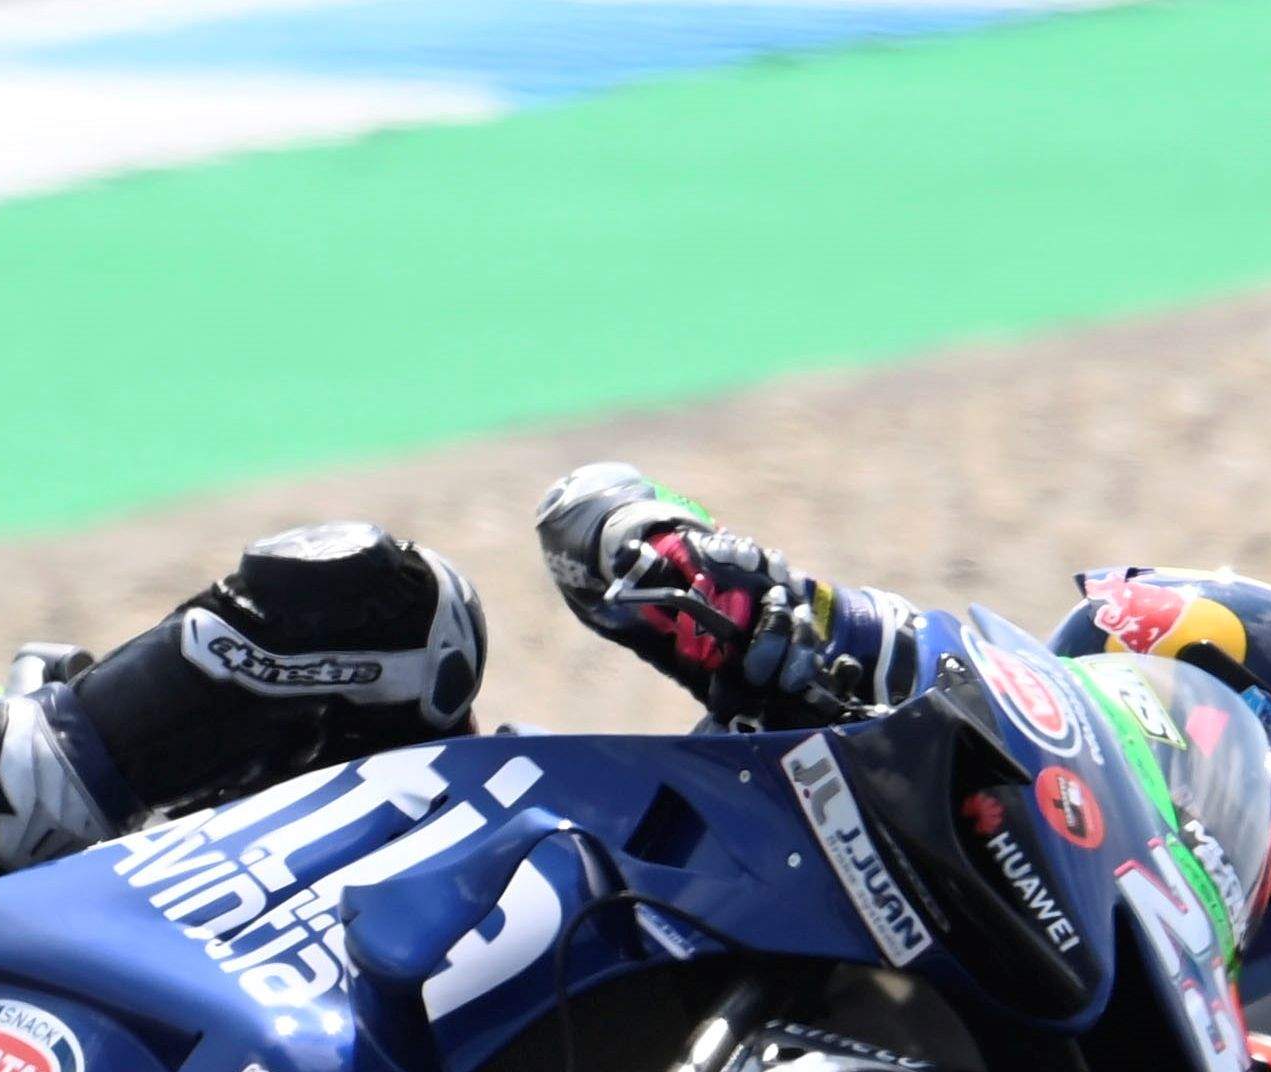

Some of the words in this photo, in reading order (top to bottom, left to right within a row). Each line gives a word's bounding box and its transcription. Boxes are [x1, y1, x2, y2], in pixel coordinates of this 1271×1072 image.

[209, 637, 383, 685] alpinestars
[834, 827, 925, 950] J.JUAN
[986, 831, 1080, 953] HUAWEI
[0, 1005, 60, 1047] SNACK
